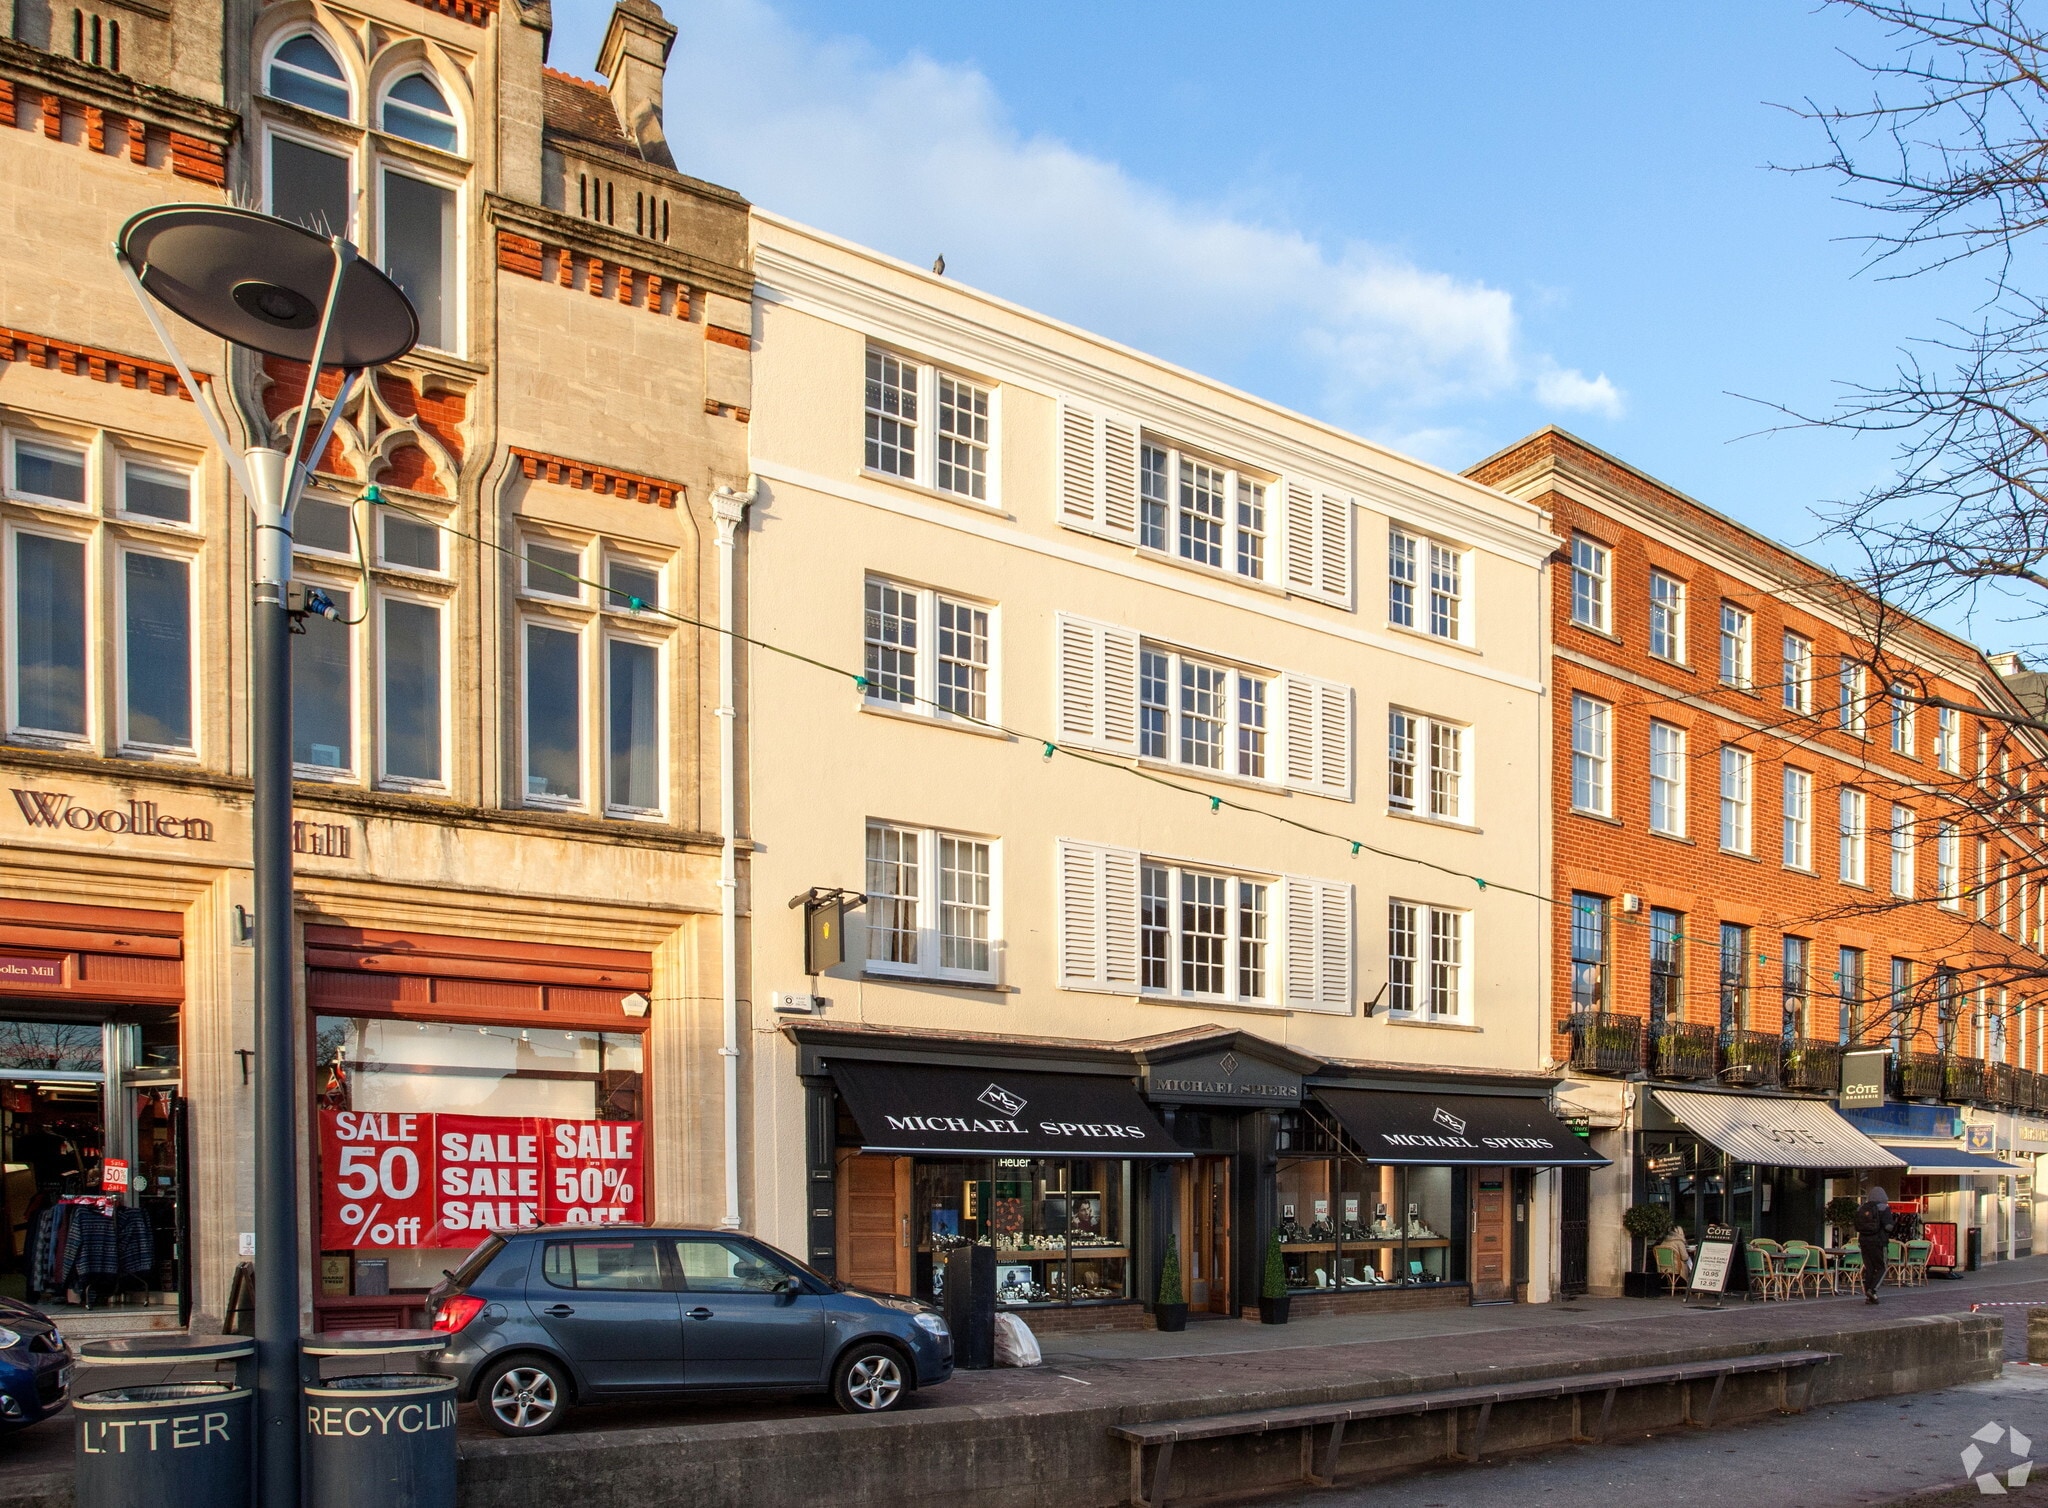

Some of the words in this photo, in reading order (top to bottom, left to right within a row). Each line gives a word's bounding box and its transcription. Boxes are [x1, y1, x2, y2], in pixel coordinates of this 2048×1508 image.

[10, 788, 215, 842] Woollen
[0, 965, 28, 975] ollen
[31, 966, 54, 976] Mill
[1156, 1079, 1237, 1094] MICHAEL
[1240, 1084, 1298, 1097] SPIERS
[1846, 1084, 1878, 1094] CÔTE
[336, 1112, 418, 1142] SALE
[885, 1115, 1029, 1133] MICHAEL
[1039, 1121, 1146, 1139] SPIERS
[441, 1132, 538, 1163] SALE
[555, 1124, 633, 1159] SALE
[1381, 1133, 1479, 1148] MICHAEL
[1482, 1137, 1554, 1149] SPIERS
[106, 1169, 120, 1181] 50
[337, 1146, 420, 1200] 50
[1000, 1159, 1030, 1167] Heuer
[442, 1166, 538, 1197] SALE
[556, 1168, 634, 1204] 50%
[442, 1201, 538, 1230] SALE
[1707, 1226, 1732, 1236] CÔTE
